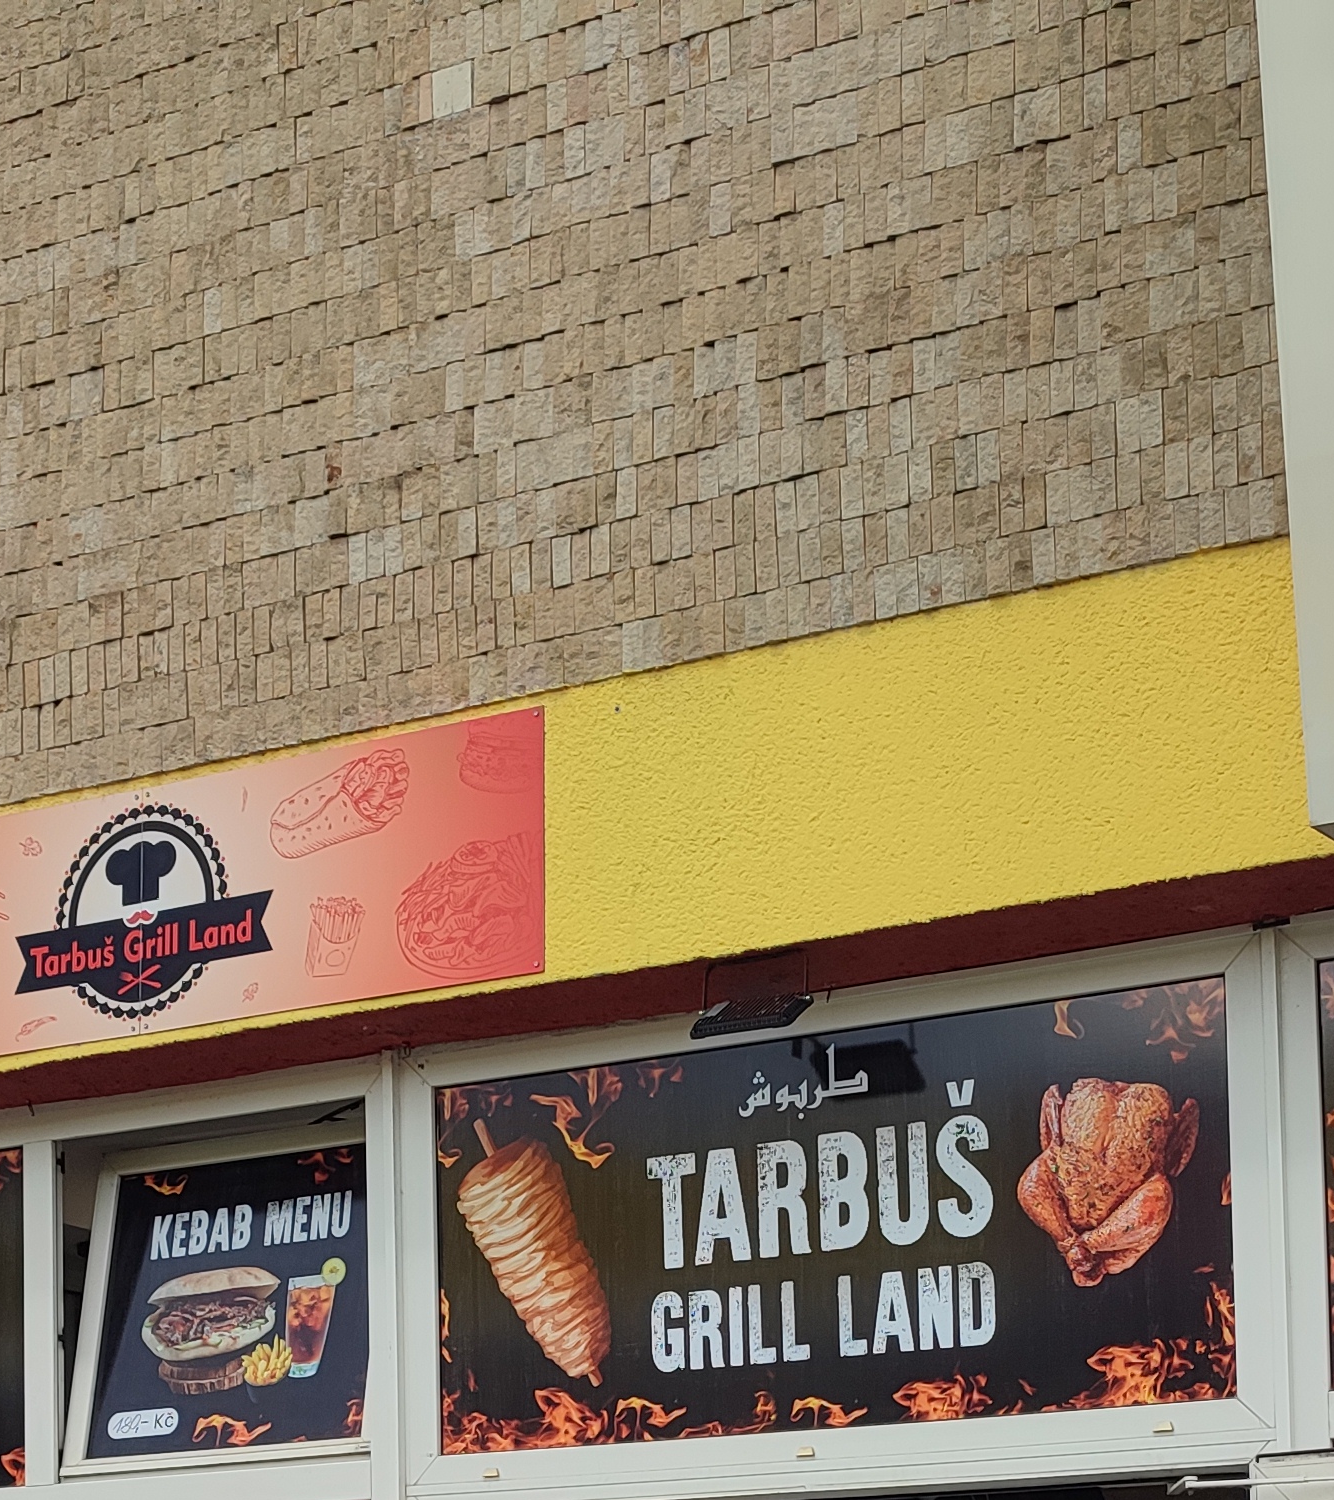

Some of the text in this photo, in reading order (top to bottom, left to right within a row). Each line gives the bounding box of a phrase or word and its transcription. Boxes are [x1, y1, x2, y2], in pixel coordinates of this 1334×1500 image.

[30, 909, 253, 979] Tarbuš Grill Land
[646, 1079, 994, 1270] TARBUŠ
[150, 1190, 353, 1261] KEBAB MENU
[651, 1262, 996, 1373] GRILL LAND
[152, 1413, 175, 1431] Kč
